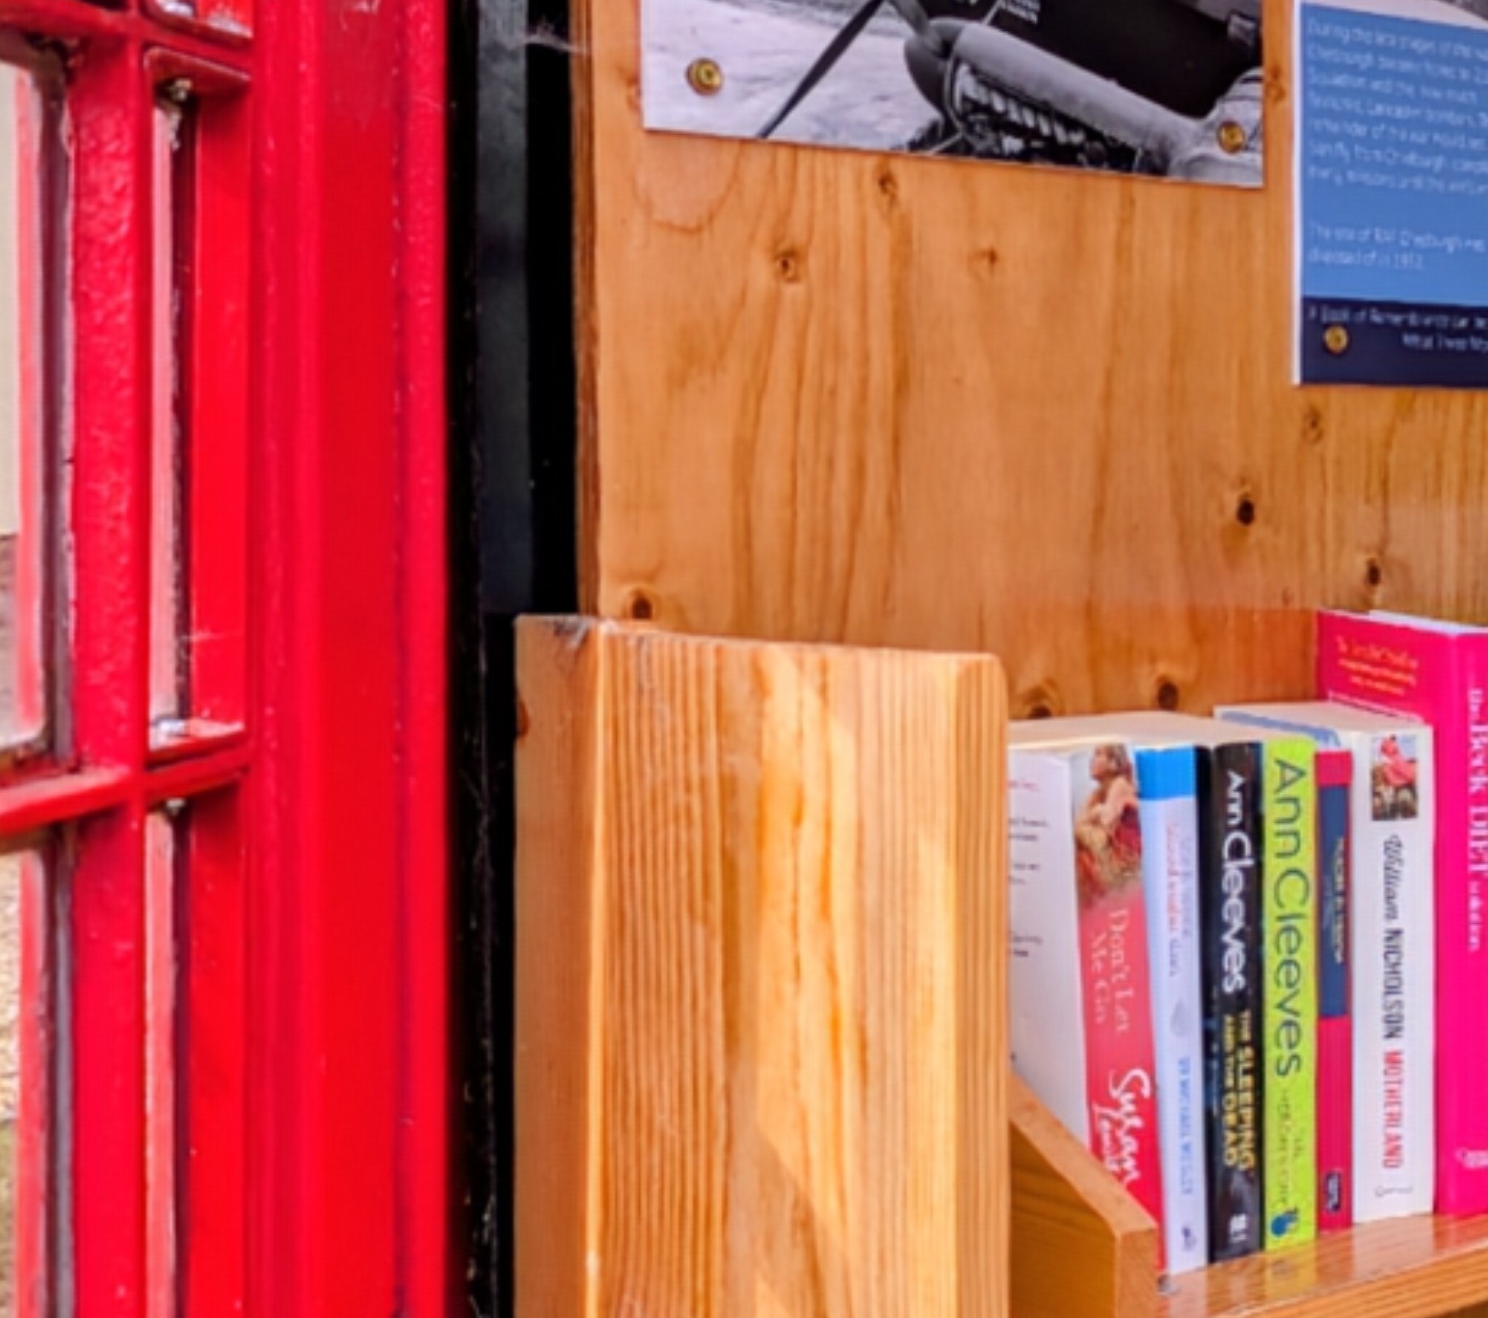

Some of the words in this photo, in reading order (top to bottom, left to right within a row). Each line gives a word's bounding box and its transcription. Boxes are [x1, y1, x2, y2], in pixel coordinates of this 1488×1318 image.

[1468, 688, 1485, 721] the
[1223, 770, 1245, 828] Ann
[1273, 757, 1307, 857] Ann
[1219, 831, 1251, 994] Cleeves
[1380, 834, 1403, 923] William
[1090, 932, 1105, 973] Me
[1109, 908, 1129, 984] Don't
[1272, 867, 1309, 1078] Cleeves
[1381, 927, 1402, 1039] NICHOLSON
[1091, 978, 1108, 1024] Go
[1112, 988, 1132, 1035] Let
[1236, 1010, 1250, 1043] THE
[1223, 1055, 1235, 1088] THE
[1235, 1045, 1253, 1171] SLEEPING
[1381, 1049, 1402, 1169] MOTHERLAND
[1107, 1067, 1151, 1185] Susan
[1221, 1092, 1237, 1169] DEAD
